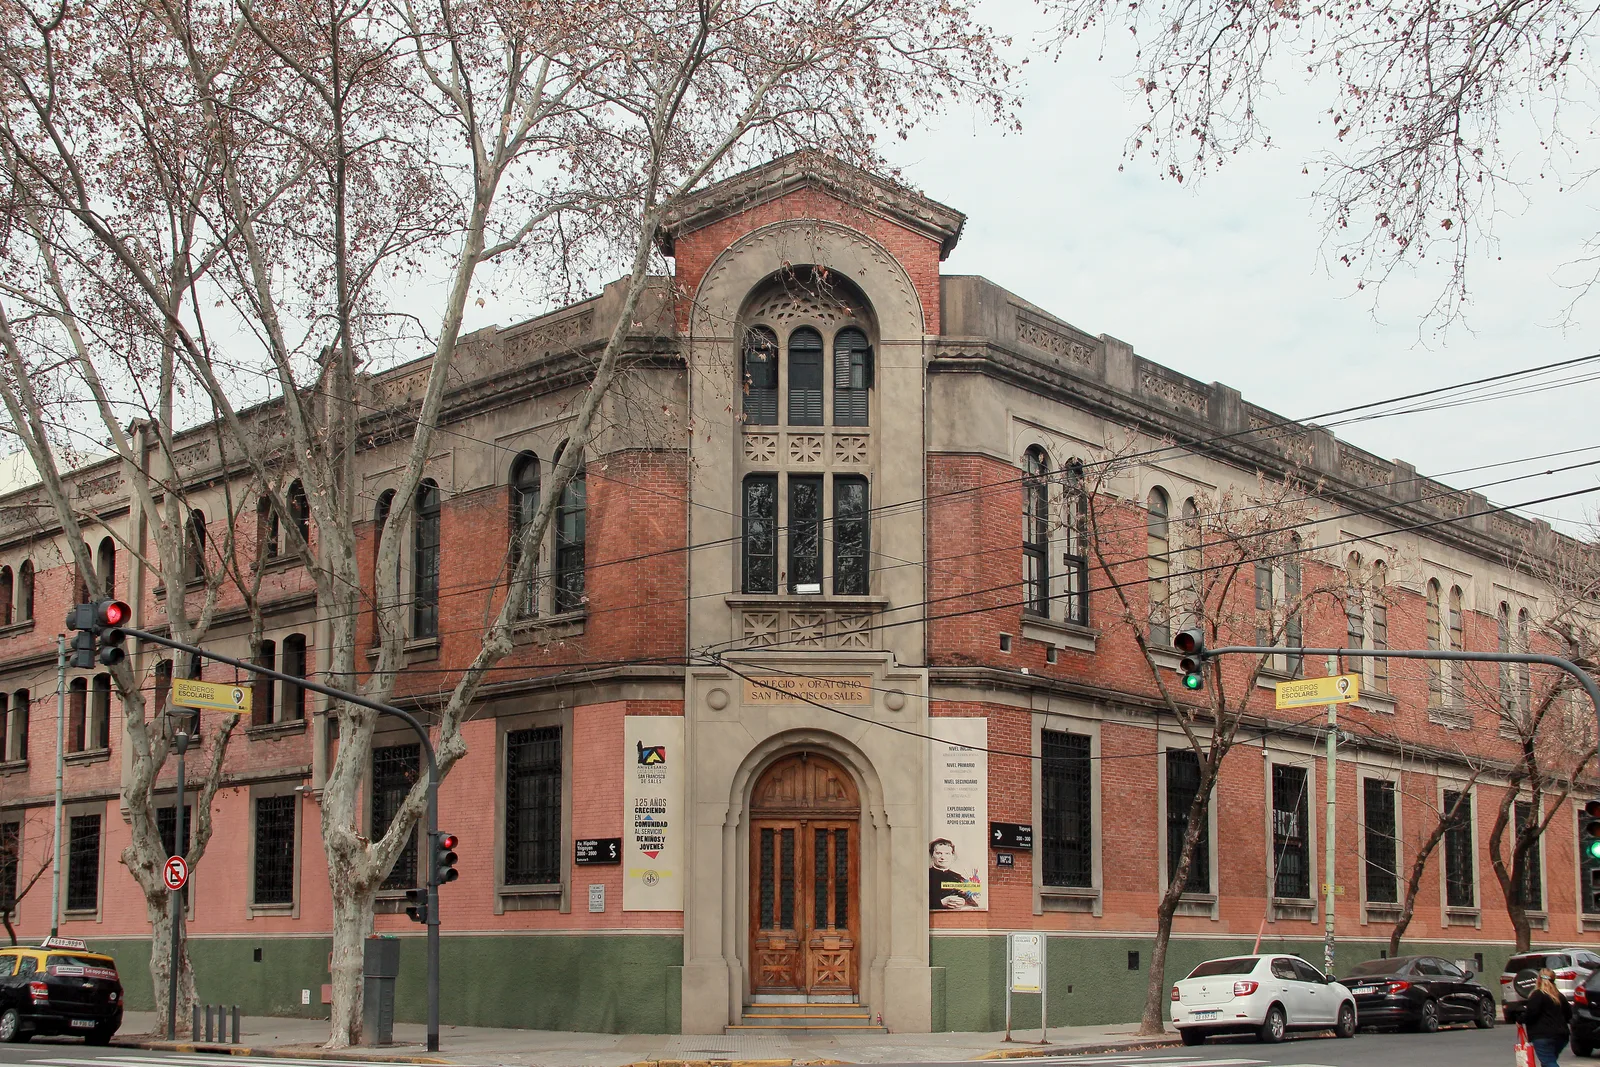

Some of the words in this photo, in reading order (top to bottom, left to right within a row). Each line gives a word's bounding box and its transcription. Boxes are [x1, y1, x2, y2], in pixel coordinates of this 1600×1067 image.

[752, 680, 795, 688] COLEGIO
[807, 680, 861, 688] ORATORIO
[1282, 684, 1318, 693] SENDEROS
[178, 684, 214, 694] SENDEROS
[178, 690, 215, 700] ESCOLARES
[751, 692, 771, 700] SAN
[775, 692, 828, 700] FRANCISCO
[834, 692, 863, 700] SALES
[1281, 690, 1318, 699] ESCOLARES
[635, 798, 648, 806] 125
[650, 797, 667, 806] AÑOS
[170, 863, 180, 882] E
